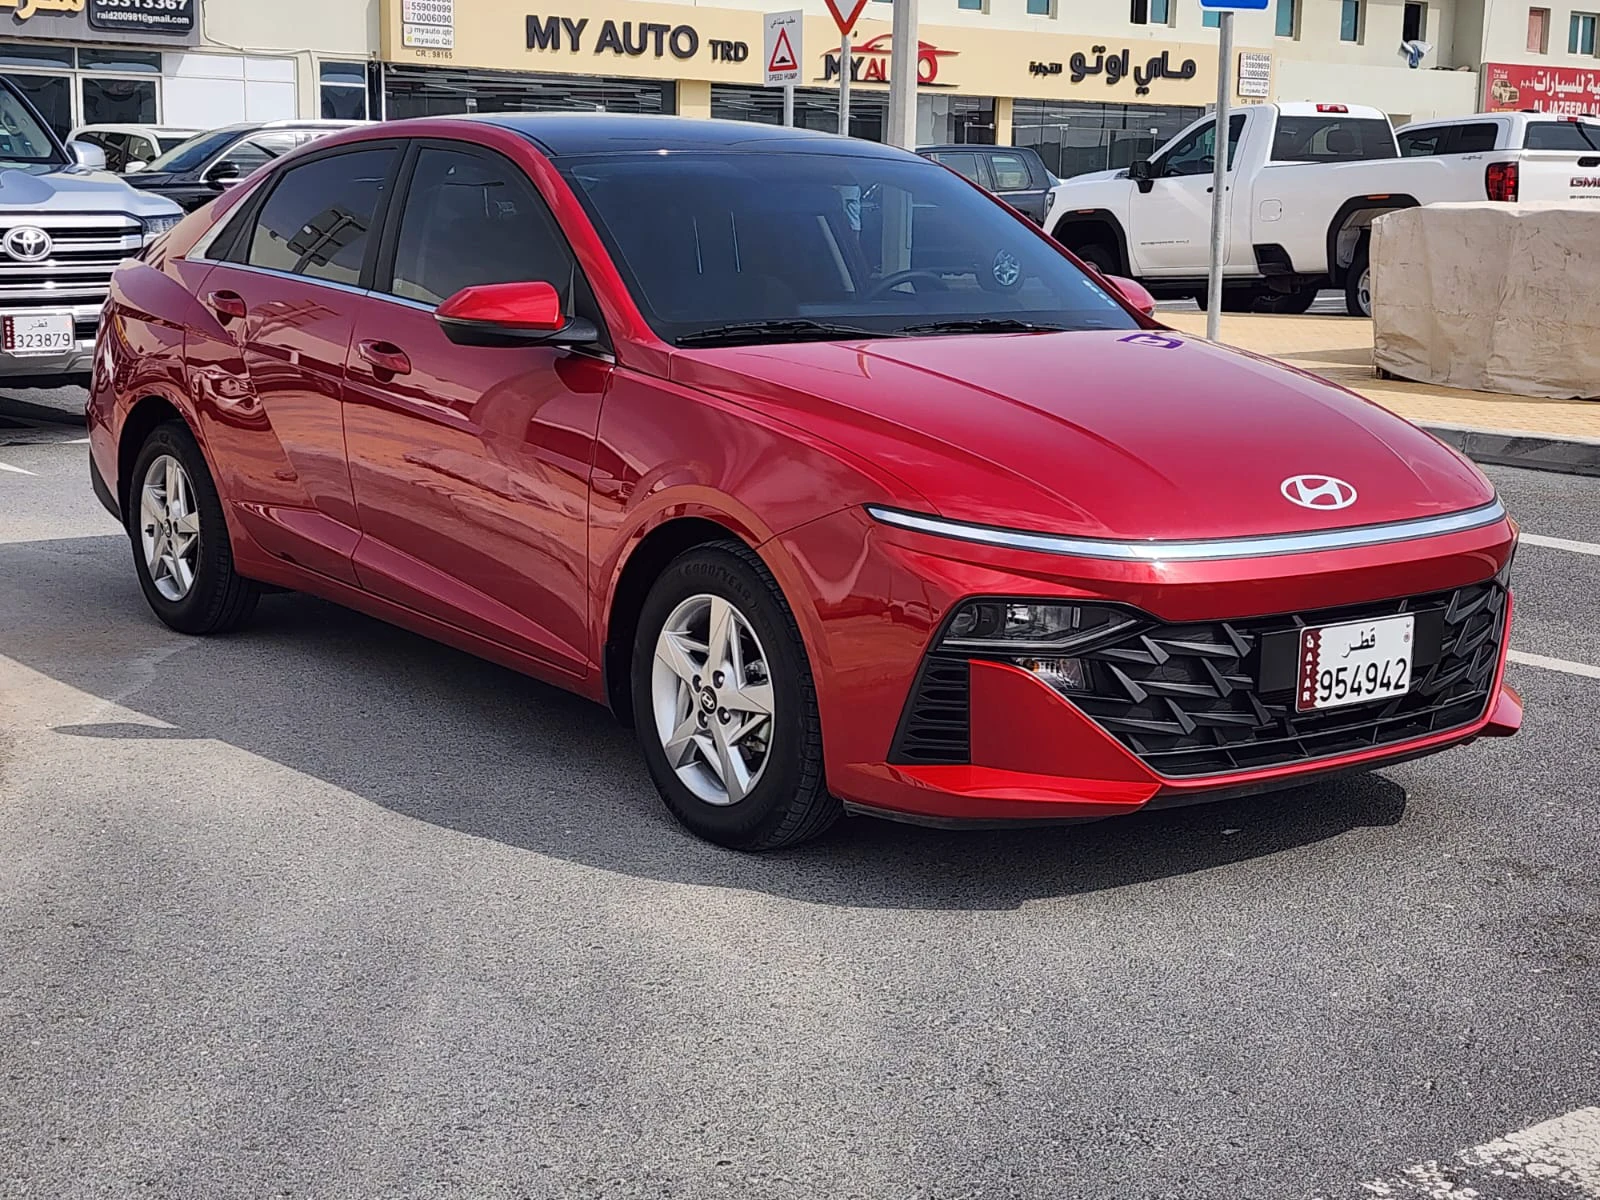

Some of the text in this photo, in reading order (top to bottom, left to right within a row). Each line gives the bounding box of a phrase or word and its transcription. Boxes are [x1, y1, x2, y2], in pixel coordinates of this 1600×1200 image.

[411, 2, 452, 13] 55909099
[411, 12, 452, 23] 70006090
[526, 14, 749, 62] MY AUTO TRD
[1134, 51, 1197, 95] ماي
[1546, 100, 1588, 115] JAZEERA
[1570, 176, 1600, 187] GM
[16, 332, 71, 348] 323879
[1341, 627, 1376, 659] قطر
[1302, 634, 1315, 702] QATAR
[1319, 657, 1407, 702] 954942
